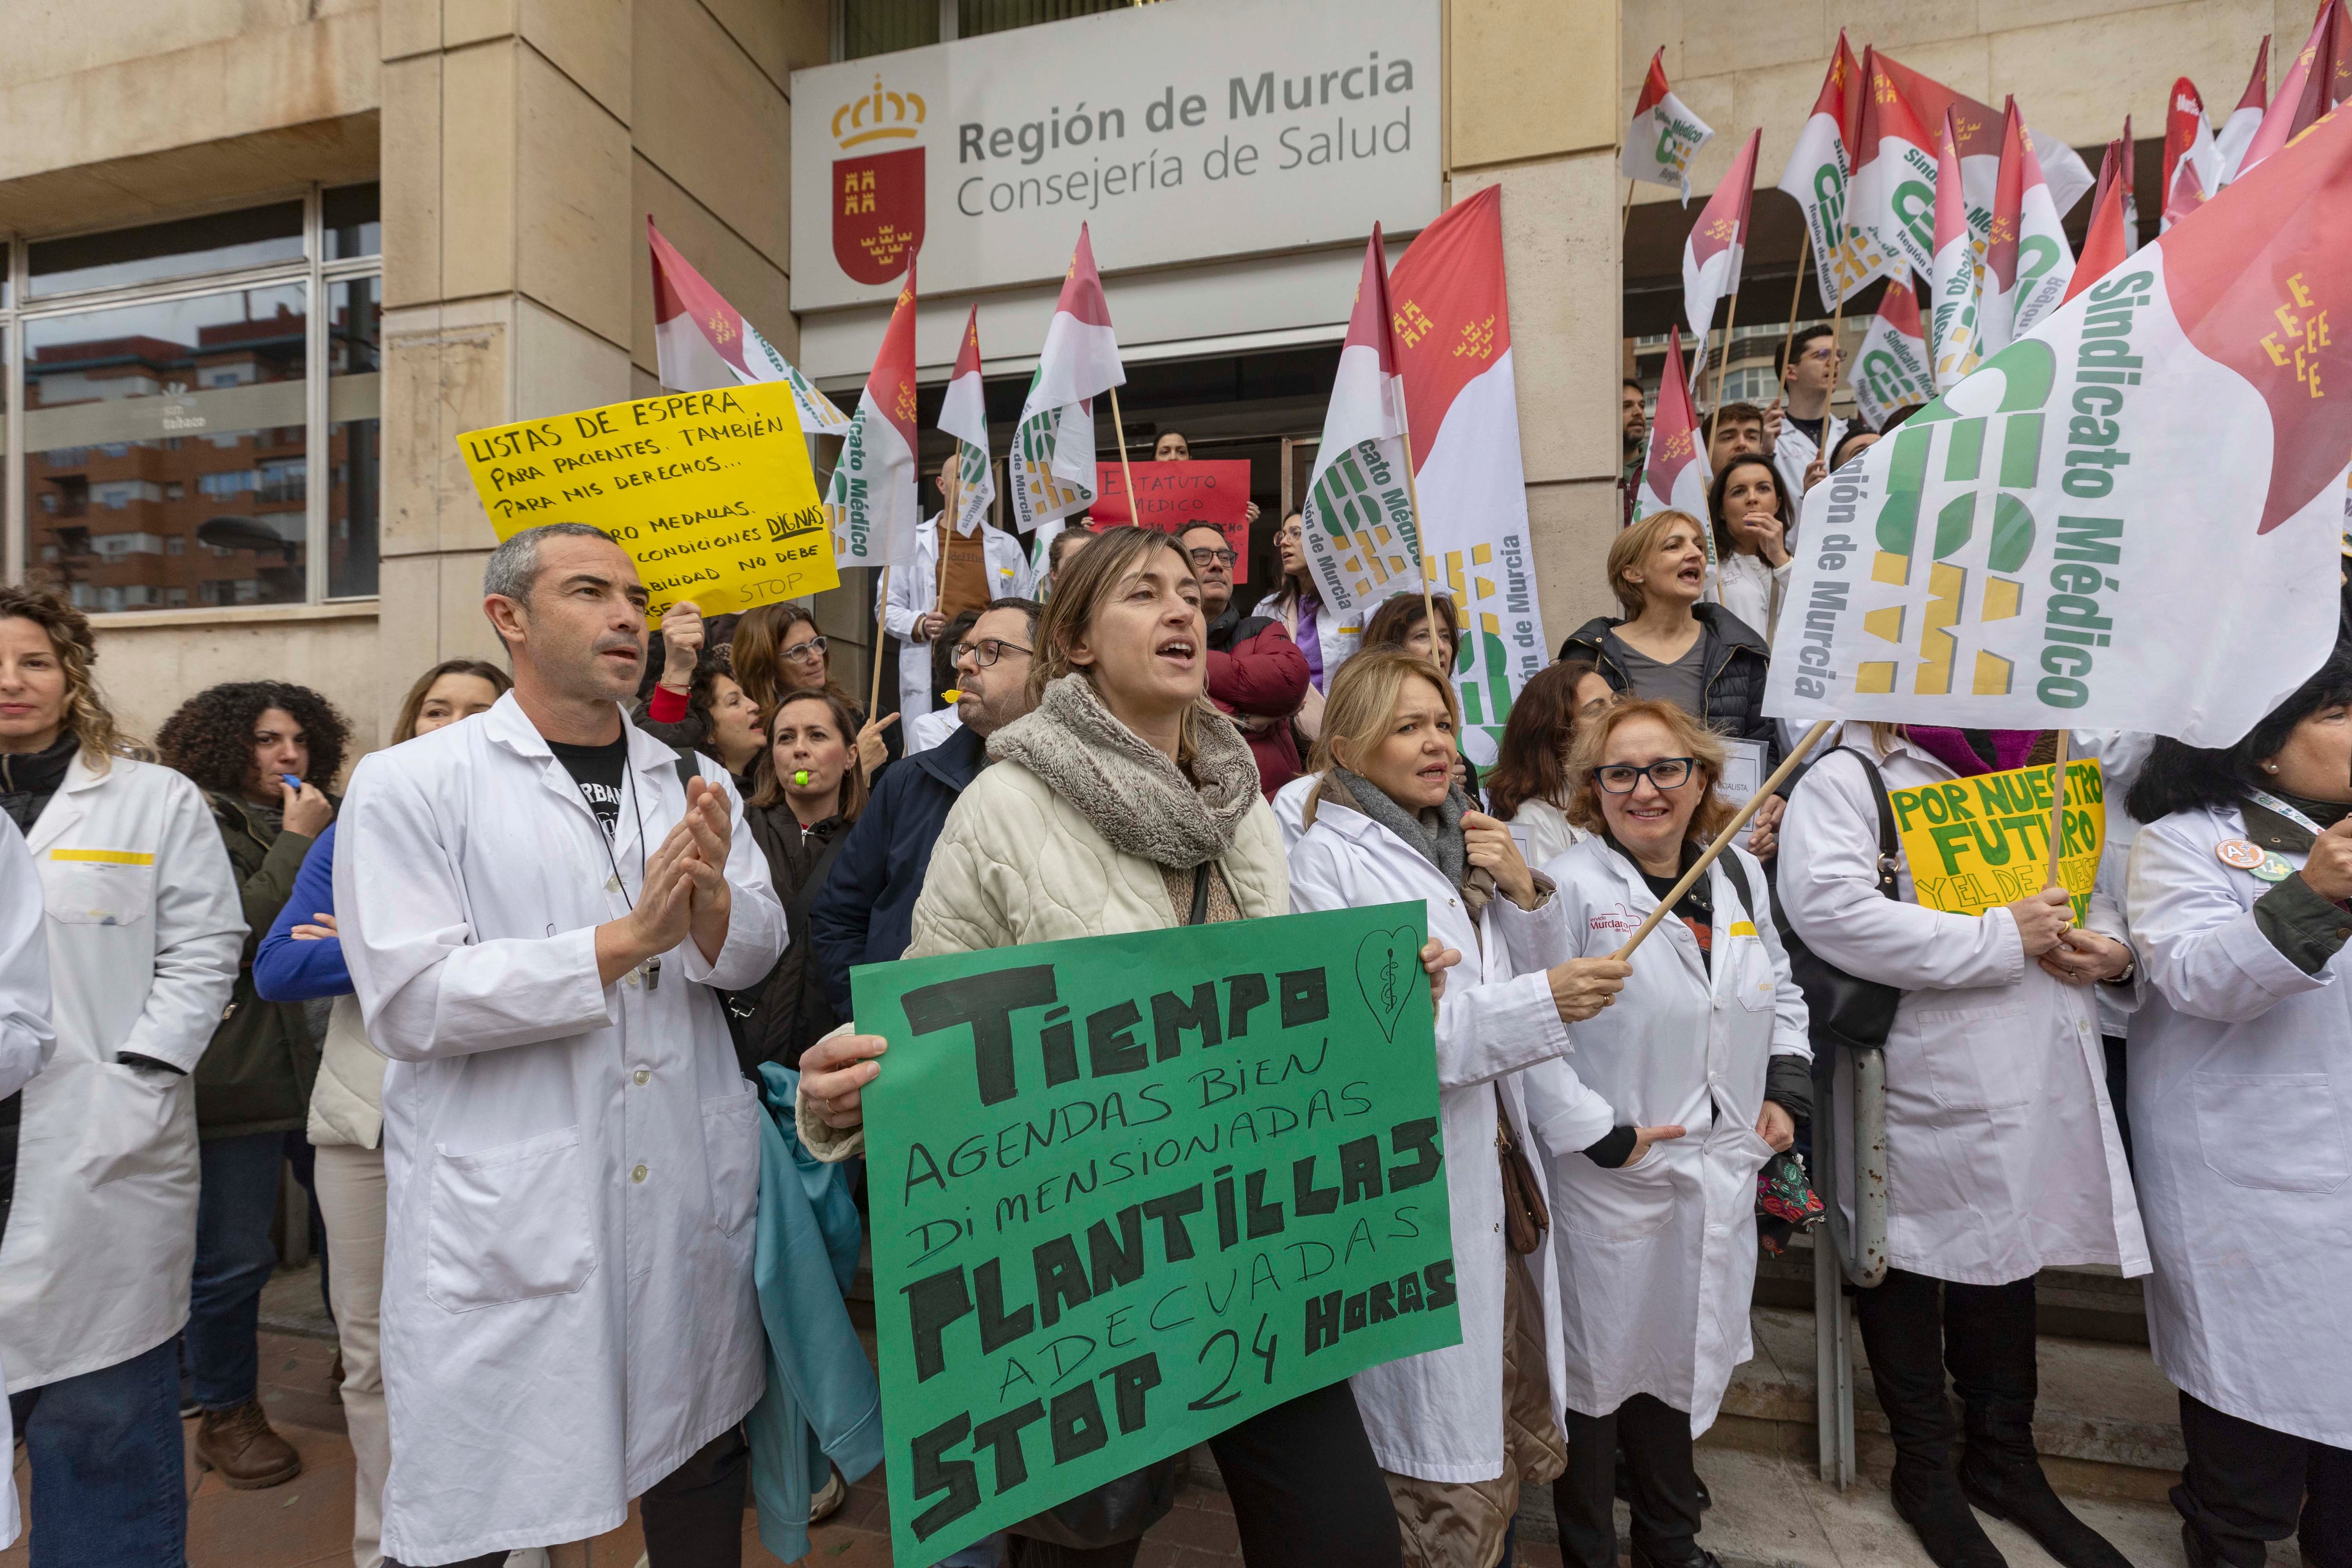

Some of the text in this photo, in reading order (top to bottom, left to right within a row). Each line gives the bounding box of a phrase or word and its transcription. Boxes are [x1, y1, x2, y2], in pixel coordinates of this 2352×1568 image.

[958, 51, 1414, 166] Región de Murcia
[1671, 119, 1703, 143] Médico
[957, 107, 1412, 217] Consejería de Salud
[1809, 204, 1821, 245] Región
[1817, 246, 1825, 261] de
[1897, 230, 1925, 271] Región
[1883, 330, 1921, 372] Sindicato
[470, 391, 745, 463] LISTAS DE ESPERA
[491, 467, 546, 492] PARA
[1014, 454, 1021, 470] de
[2036, 270, 2154, 709] Sindicato Médico
[494, 495, 557, 518] PARA
[564, 483, 603, 503] MIS
[850, 478, 870, 557] Médico
[1016, 475, 1032, 522] Murcia
[739, 556, 766, 572] NO
[776, 545, 819, 563] DEBE
[1309, 533, 1324, 553] de
[1317, 555, 1351, 610] Murcia
[1501, 534, 1530, 613] Murcia
[1818, 534, 1858, 571] de
[740, 573, 803, 603] STOP
[1513, 621, 1535, 648] de
[1795, 580, 1850, 700] Murcia
[1891, 764, 2103, 833] POR NUESTRO
[1929, 810, 2097, 876] FUTURO
[905, 1083, 1172, 1207] AGENDAS
[911, 1258, 1456, 1543] STOP 24 HORAS
